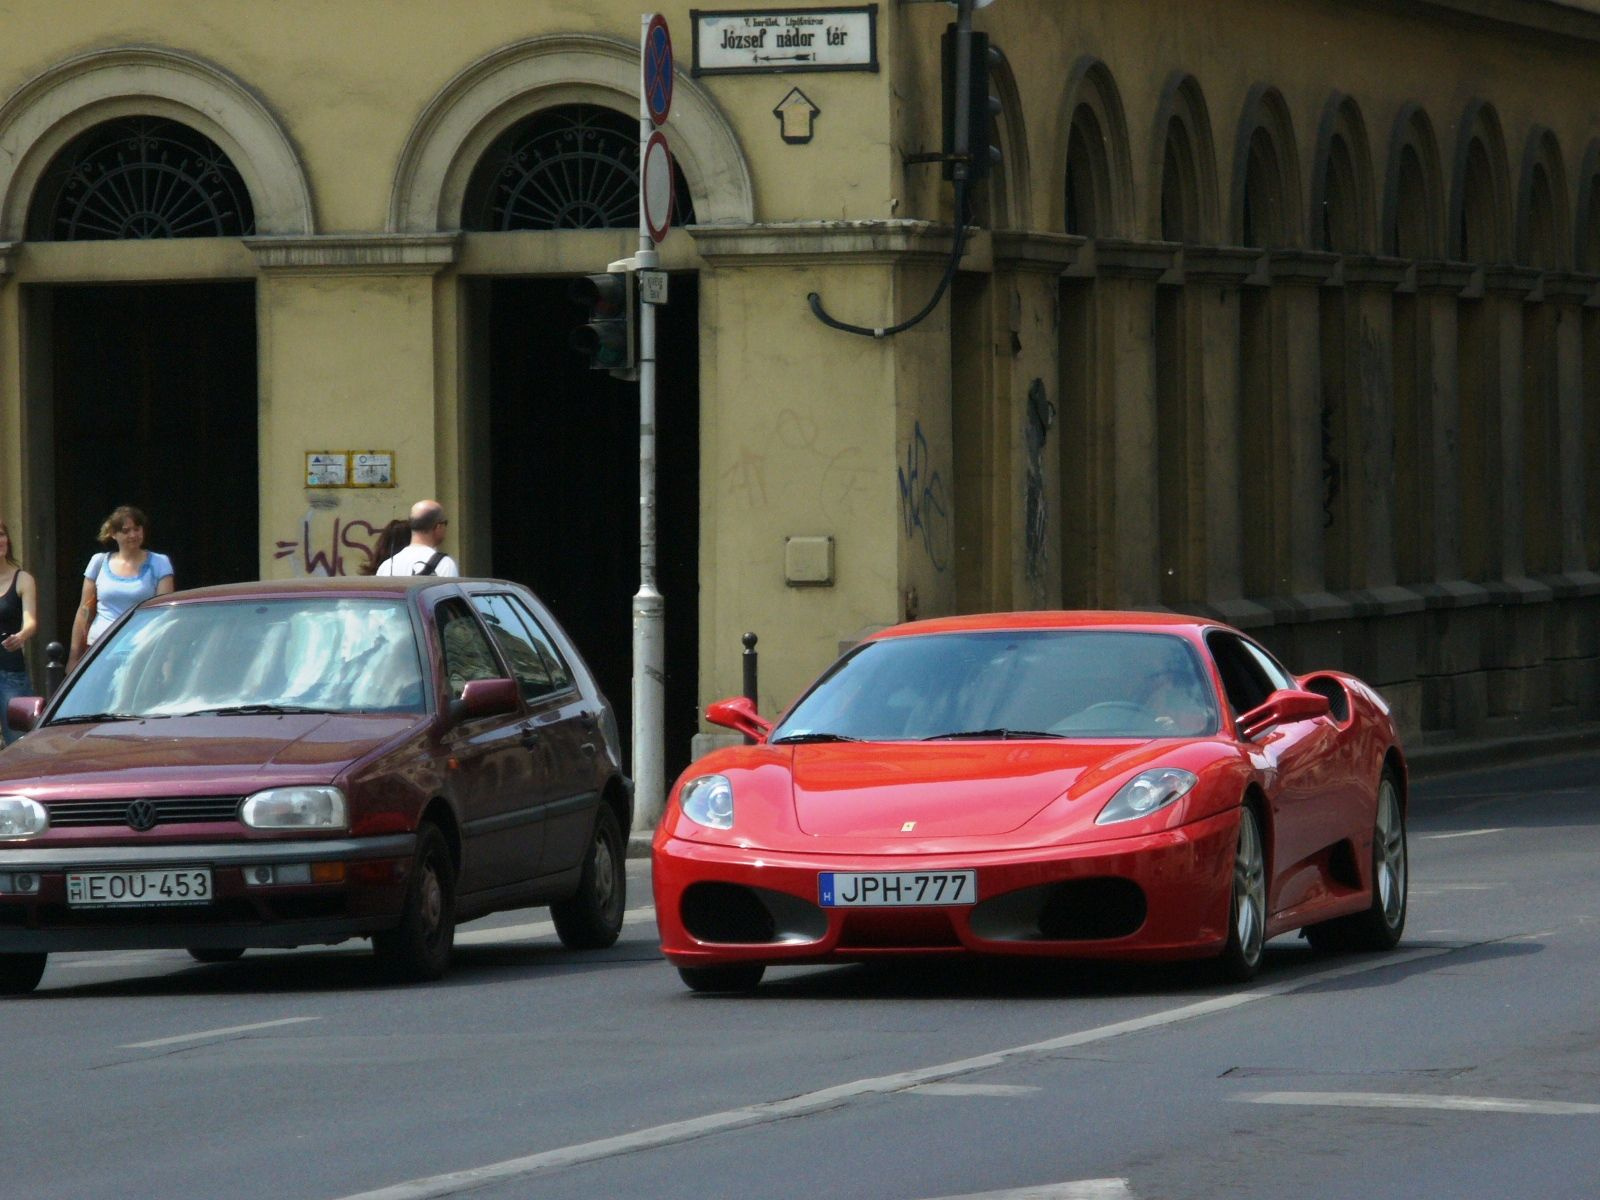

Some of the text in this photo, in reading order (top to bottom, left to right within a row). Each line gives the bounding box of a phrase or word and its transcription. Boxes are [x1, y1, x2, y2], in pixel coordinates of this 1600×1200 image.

[720, 26, 848, 49] József nádor tér
[70, 873, 208, 900] H EOU-453
[823, 875, 967, 902] H JPH-777
